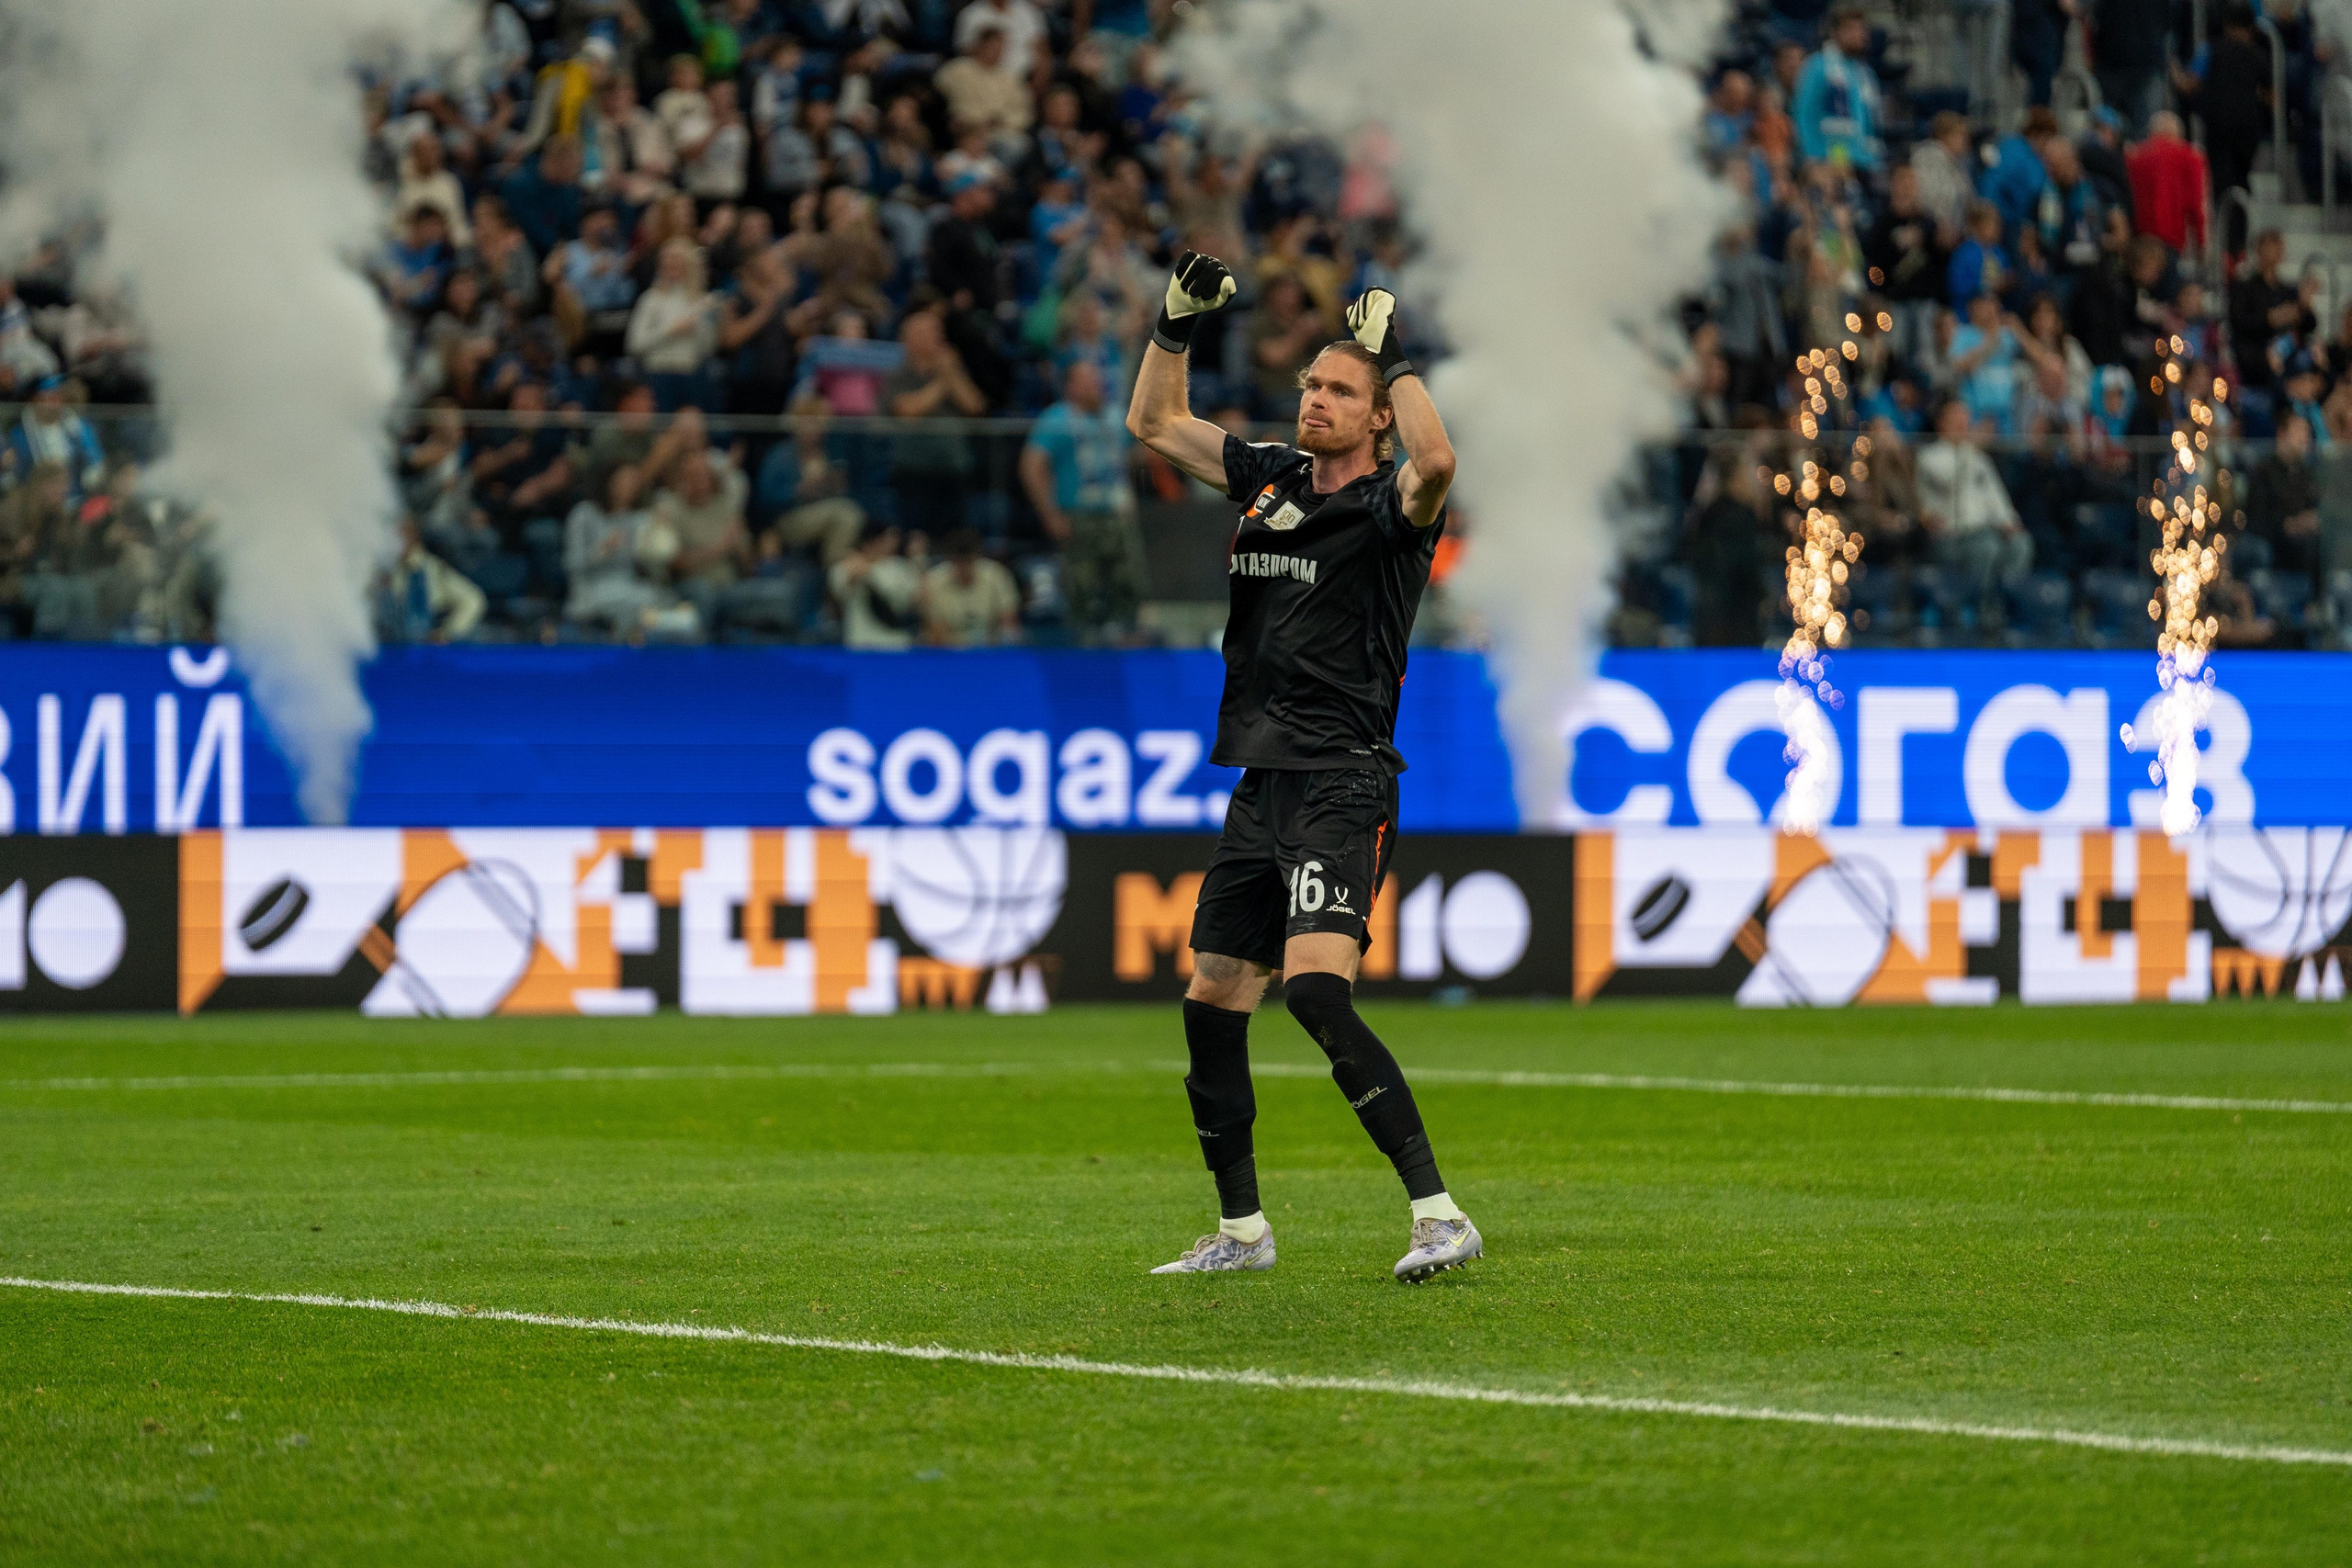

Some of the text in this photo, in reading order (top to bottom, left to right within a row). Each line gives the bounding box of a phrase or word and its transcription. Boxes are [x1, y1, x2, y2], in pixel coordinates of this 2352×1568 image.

[0, 647, 244, 833] ИЙ
[1288, 861, 1325, 918] 16
[1325, 904, 1356, 915] JÖGEL
[1351, 1086, 1388, 1109] ÖGEL
